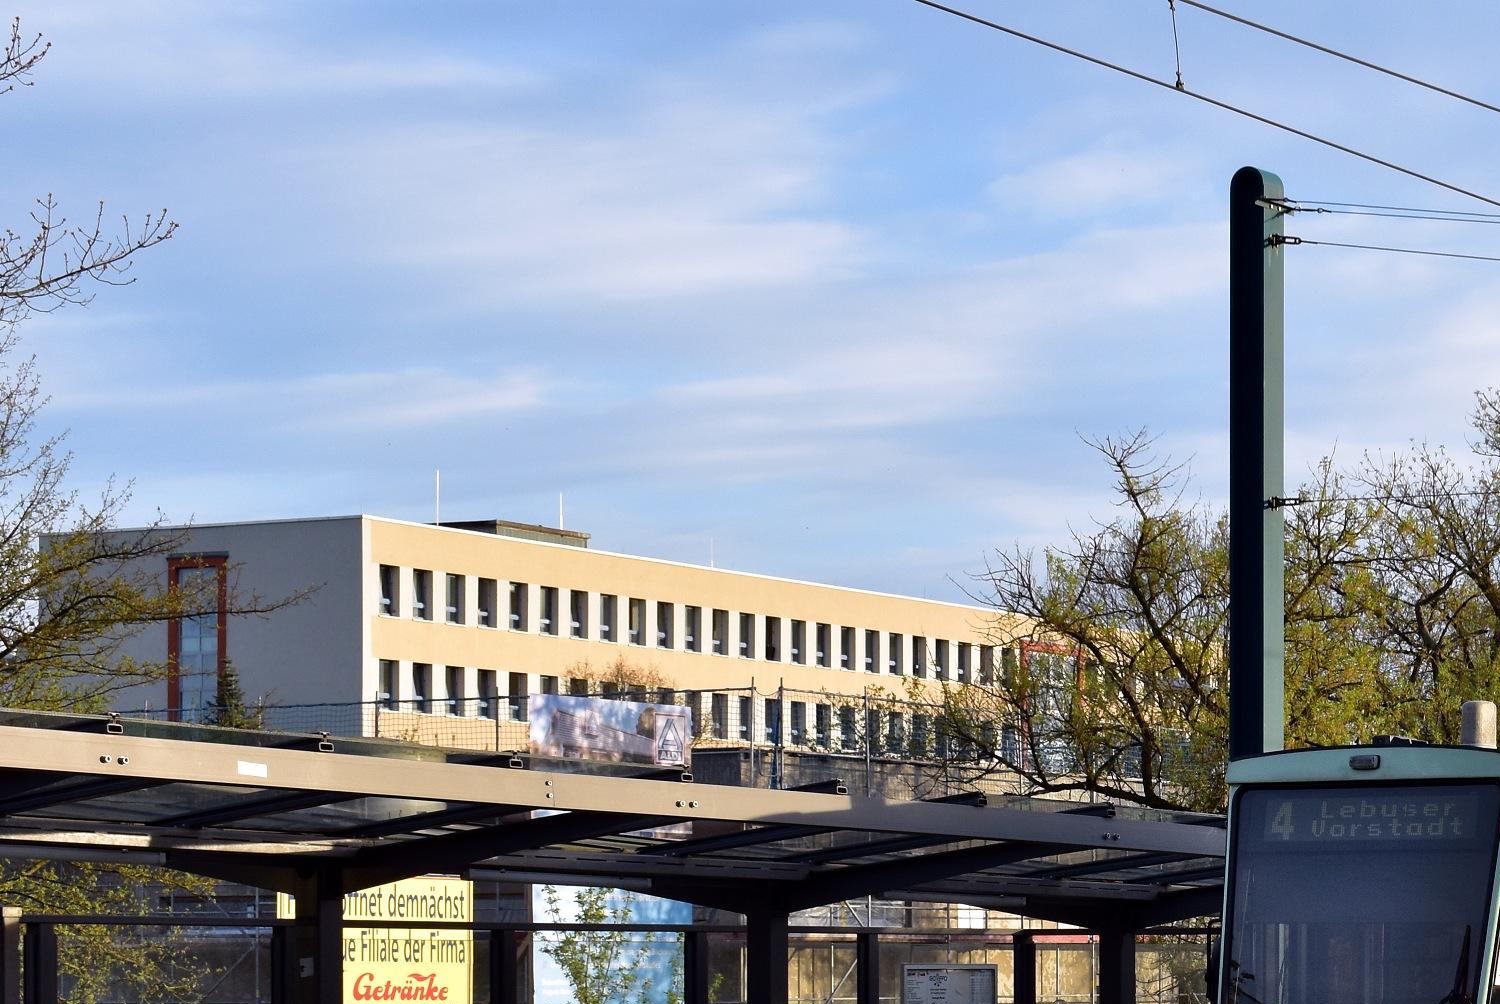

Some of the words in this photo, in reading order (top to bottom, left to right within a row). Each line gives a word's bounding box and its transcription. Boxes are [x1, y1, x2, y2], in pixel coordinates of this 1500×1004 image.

[660, 750, 681, 761] ALDI
[1271, 801, 1295, 840] 4
[1321, 800, 1457, 818] Lebuser
[1311, 816, 1463, 838] Vorstadt
[388, 883, 465, 919] demnächst
[361, 928, 399, 963] Filiale
[403, 928, 426, 963] der
[430, 930, 466, 964] Firma
[352, 972, 449, 1001] Getränke
